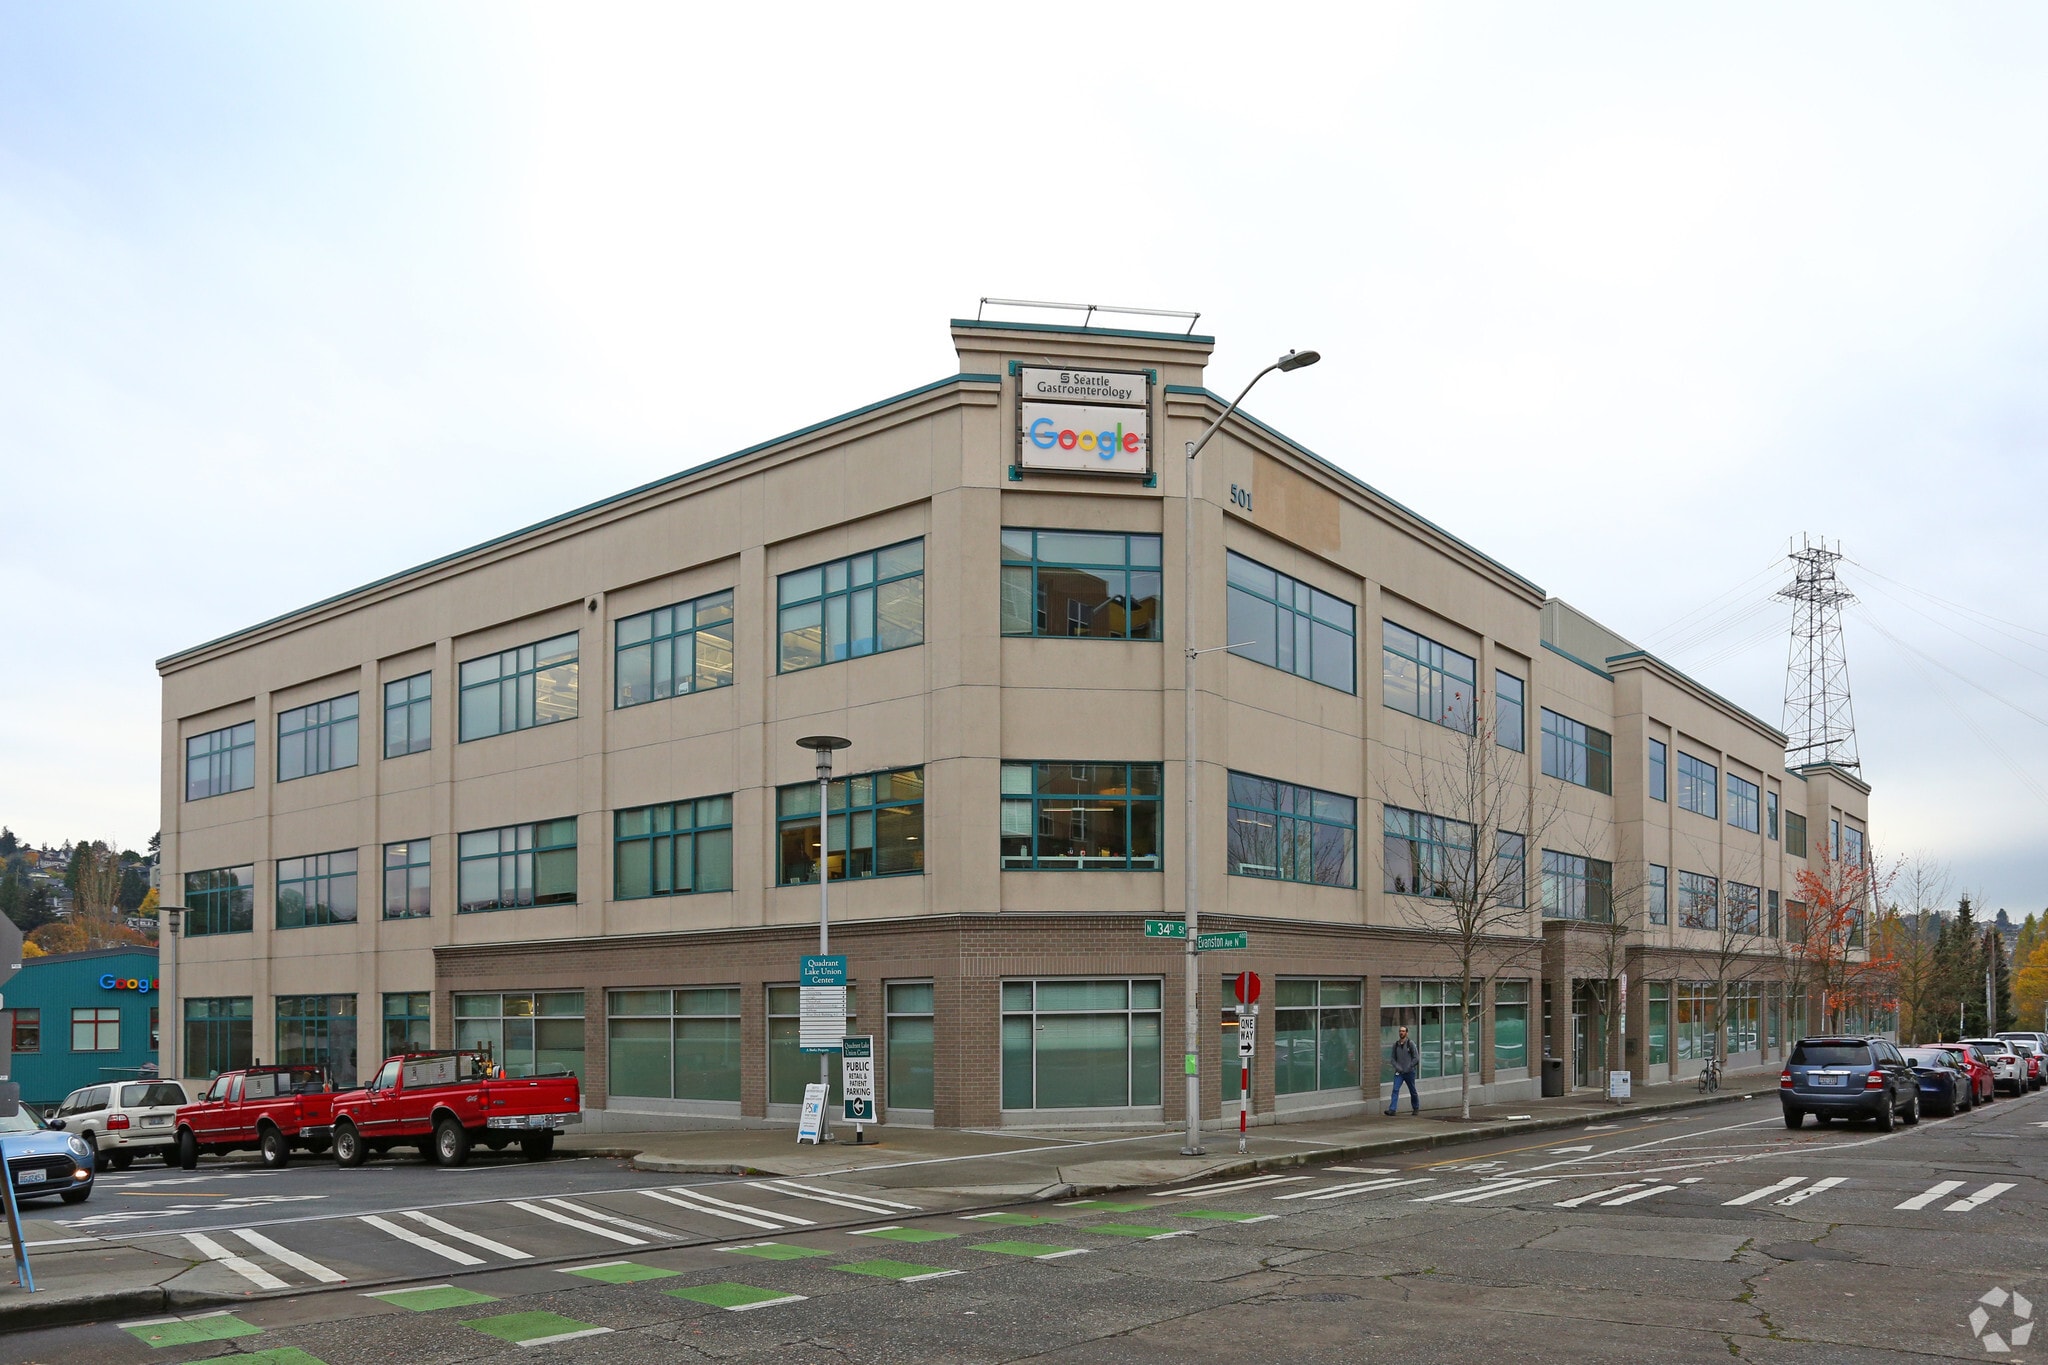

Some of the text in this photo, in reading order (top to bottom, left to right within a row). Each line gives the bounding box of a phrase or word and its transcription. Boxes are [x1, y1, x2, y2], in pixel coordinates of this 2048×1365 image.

[1074, 374, 1110, 386] Seattle
[1038, 382, 1132, 399] Gastroenterology
[1030, 418, 1139, 460] Google
[1230, 484, 1252, 512] 501
[1146, 922, 1184, 935] N 34th St
[1198, 936, 1223, 948] Evanston
[1234, 938, 1239, 946] N
[808, 959, 838, 968] Quadrant
[1241, 1019, 1253, 1029] ONE
[1241, 1031, 1253, 1040] WAY
[846, 1062, 869, 1071] PUBLIC
